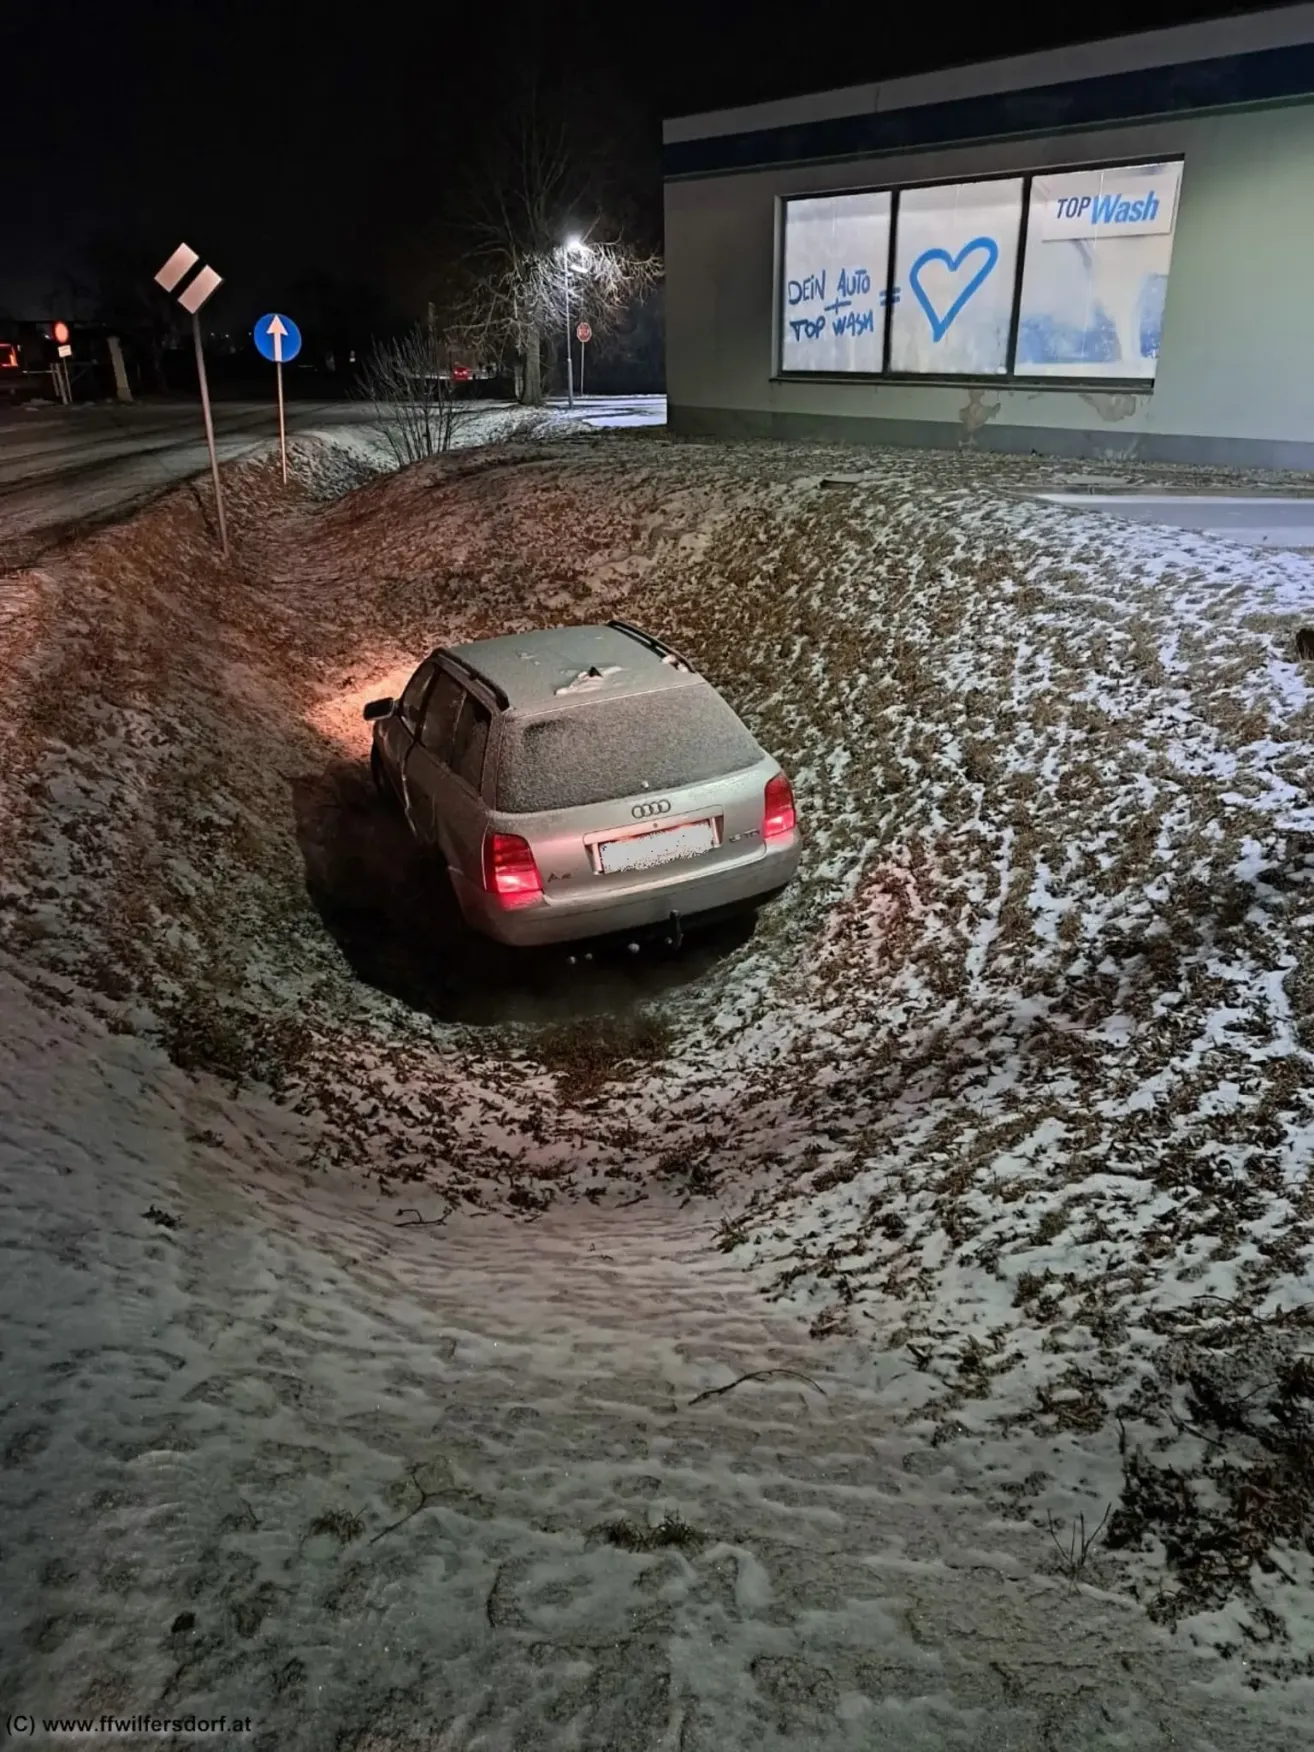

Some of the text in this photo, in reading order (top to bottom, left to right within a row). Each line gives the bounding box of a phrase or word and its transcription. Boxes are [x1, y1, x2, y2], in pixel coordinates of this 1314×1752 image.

[837, 268, 870, 297] AUTO
[789, 309, 874, 342] TOP WASH
